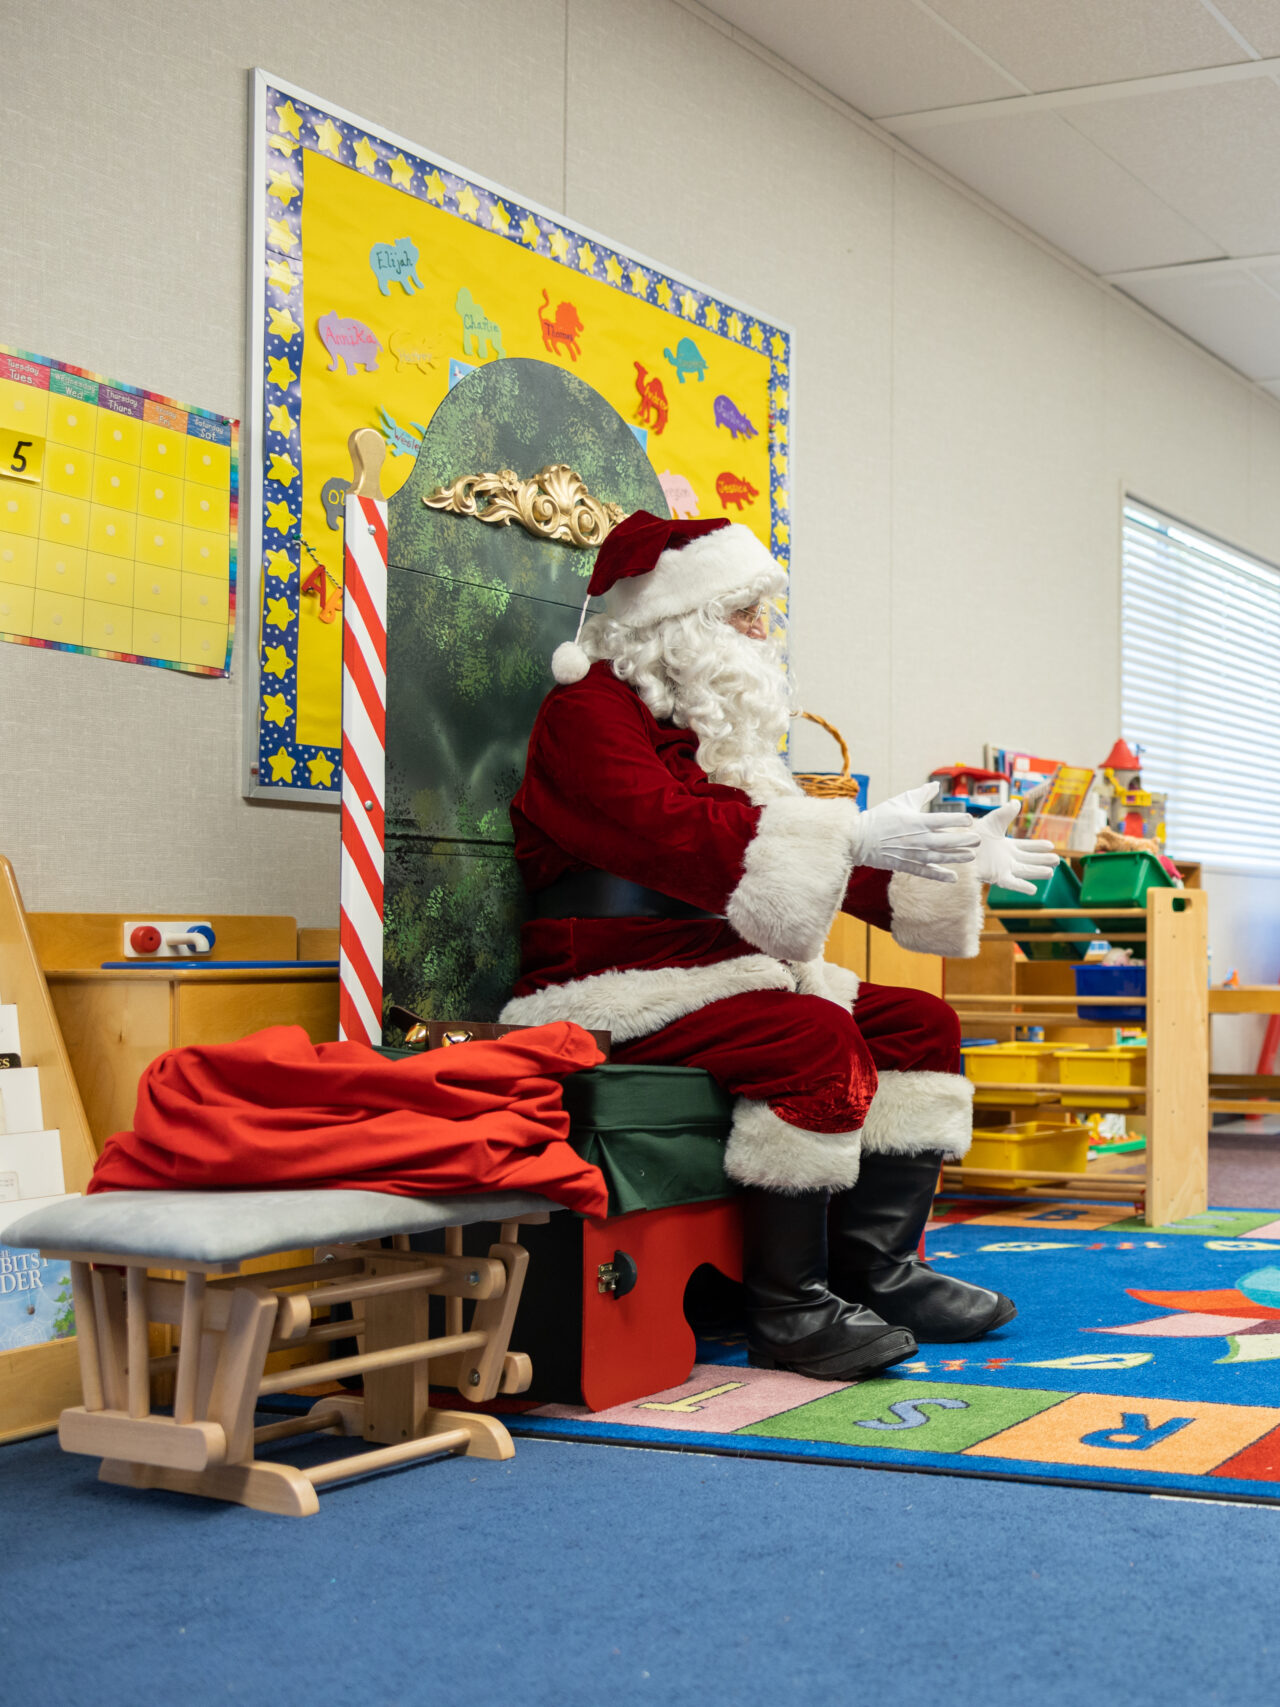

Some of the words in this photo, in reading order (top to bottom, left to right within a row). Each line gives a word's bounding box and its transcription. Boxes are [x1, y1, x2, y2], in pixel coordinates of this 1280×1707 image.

[376, 251, 413, 275] Elijah
[7, 358, 40, 376] Tuesday
[55, 373, 97, 395] Wednesday
[105, 389, 138, 408] Thursday
[194, 418, 225, 434] Saturday
[10, 441, 33, 473] 5
[302, 564, 326, 609] A
[1025, 1209, 1089, 1221] B
[633, 1381, 750, 1414] T
[852, 1397, 971, 1431] S
[1079, 1411, 1198, 1451] R
